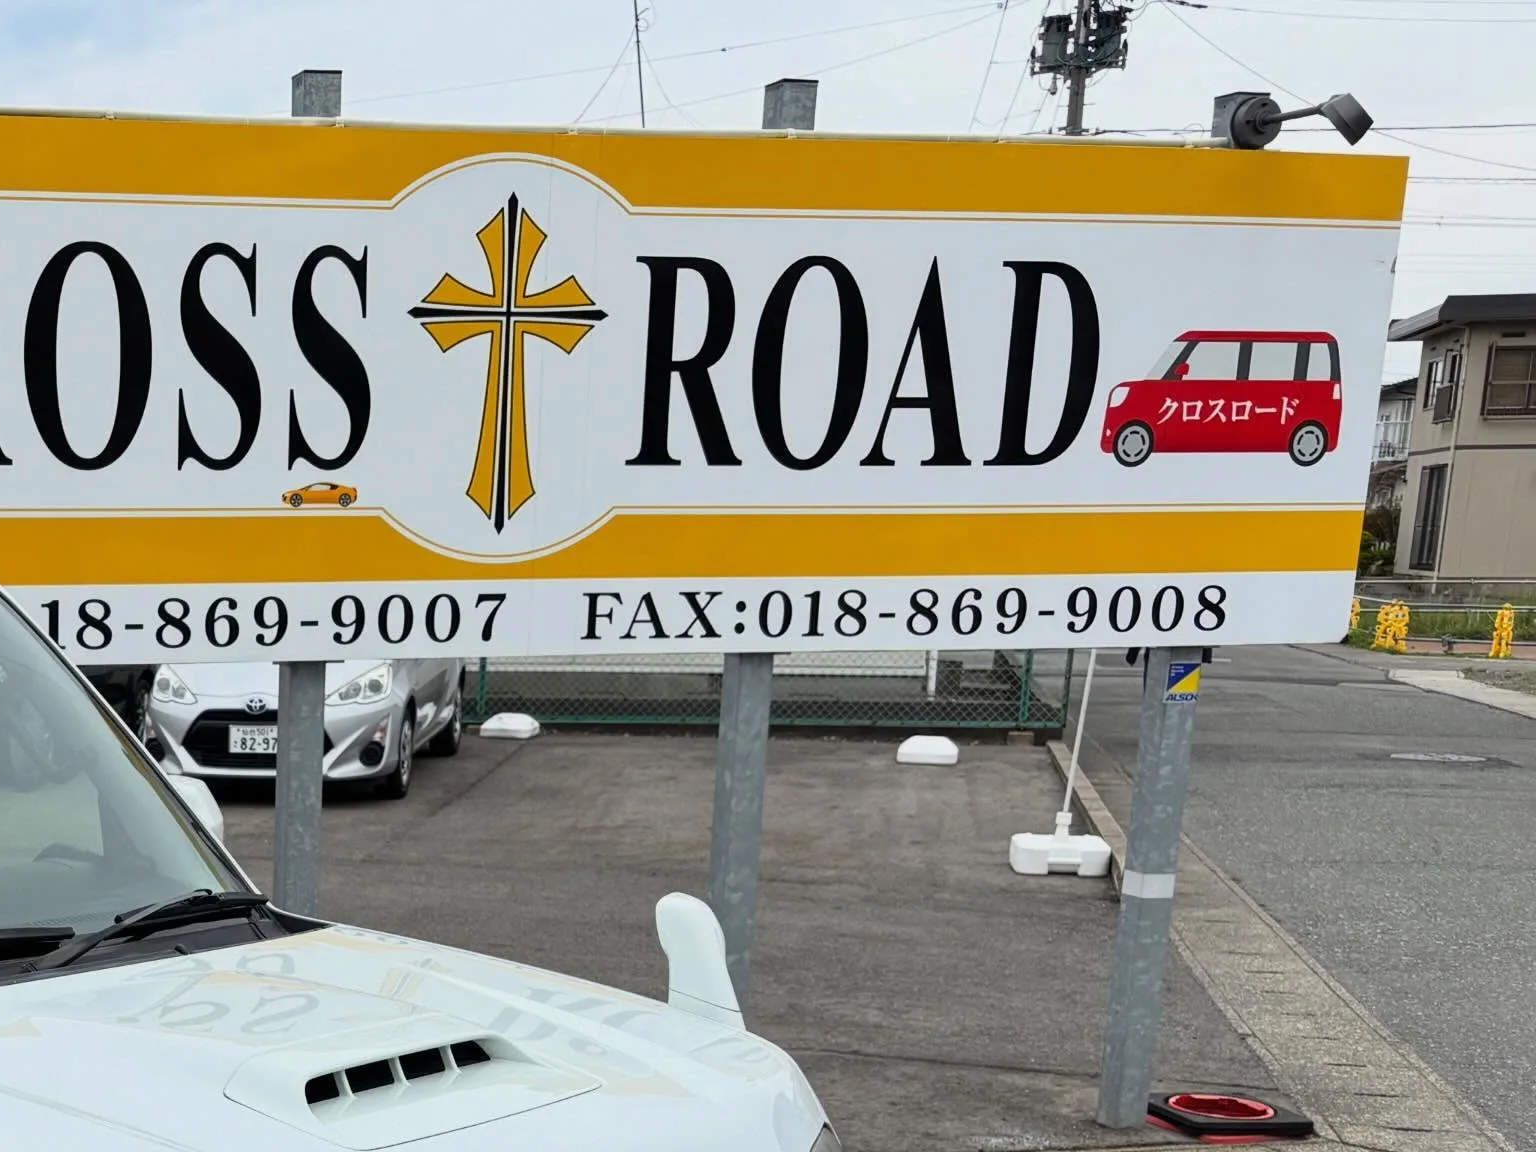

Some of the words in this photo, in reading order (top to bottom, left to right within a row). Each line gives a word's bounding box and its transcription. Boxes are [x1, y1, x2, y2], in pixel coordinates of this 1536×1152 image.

[625, 255, 1101, 471] ROAD
[1156, 396, 1300, 425] クロスロード
[580, 585, 1228, 641] FAX:018-869-9008
[240, 736, 278, 751] 82-97
